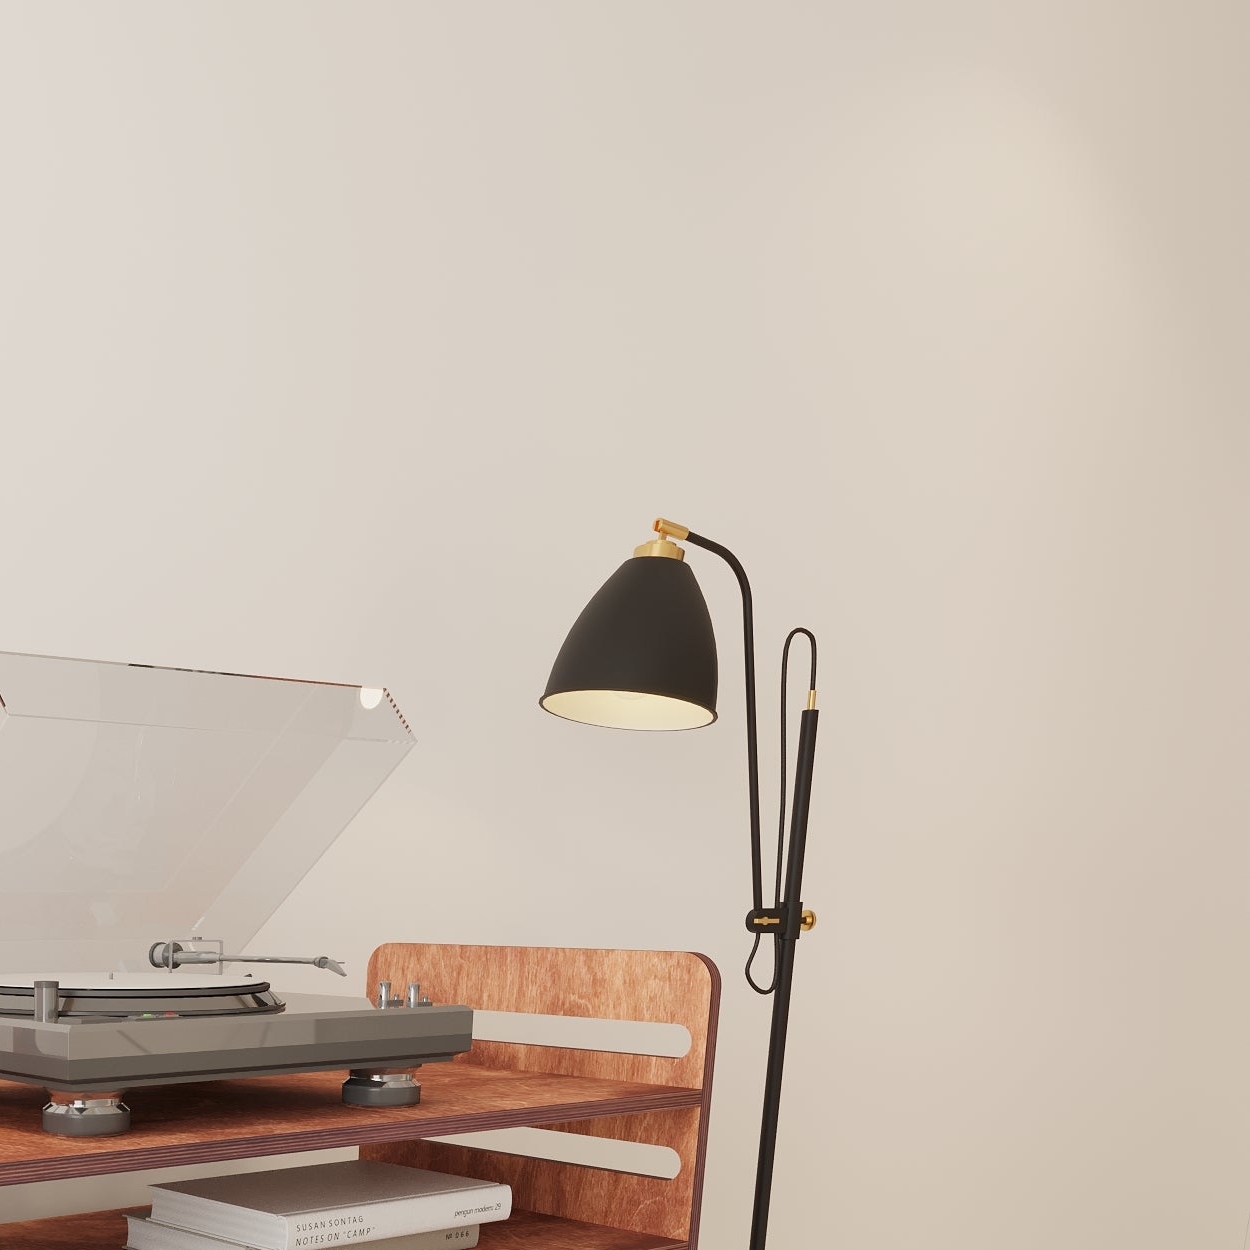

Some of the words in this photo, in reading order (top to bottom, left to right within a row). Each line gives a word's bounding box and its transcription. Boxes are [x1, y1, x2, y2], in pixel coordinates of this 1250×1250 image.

[296, 1221, 326, 1233] SUSAN
[328, 1215, 364, 1227] SONTAG
[295, 1234, 324, 1247] NOTES
[327, 1232, 340, 1242] ON
